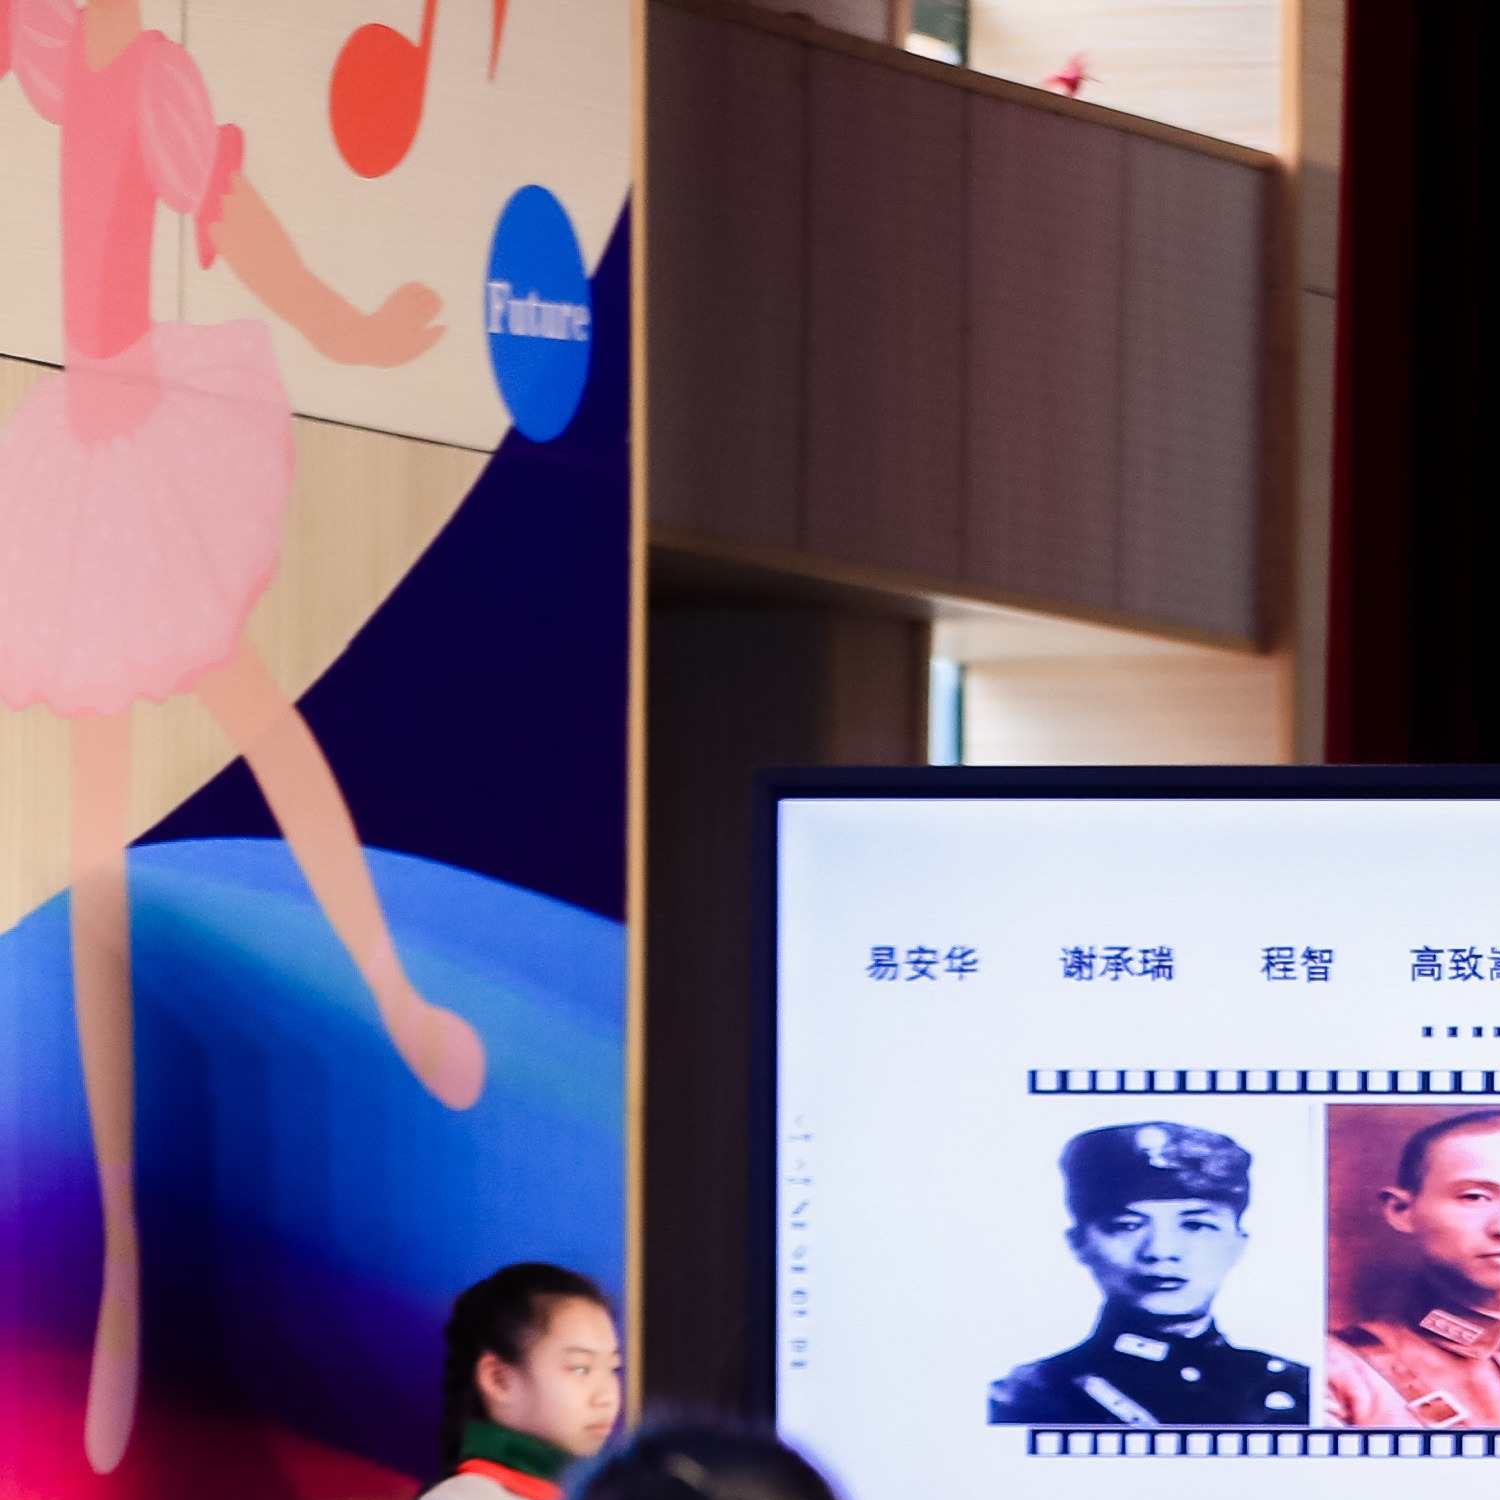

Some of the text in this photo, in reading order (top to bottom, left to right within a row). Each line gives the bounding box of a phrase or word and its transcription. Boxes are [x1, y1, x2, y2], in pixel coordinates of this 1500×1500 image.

[487, 280, 591, 342] Future
[864, 944, 979, 983] 易安华
[1060, 945, 1175, 983] 谢承瑞
[1260, 945, 1334, 984] 程智
